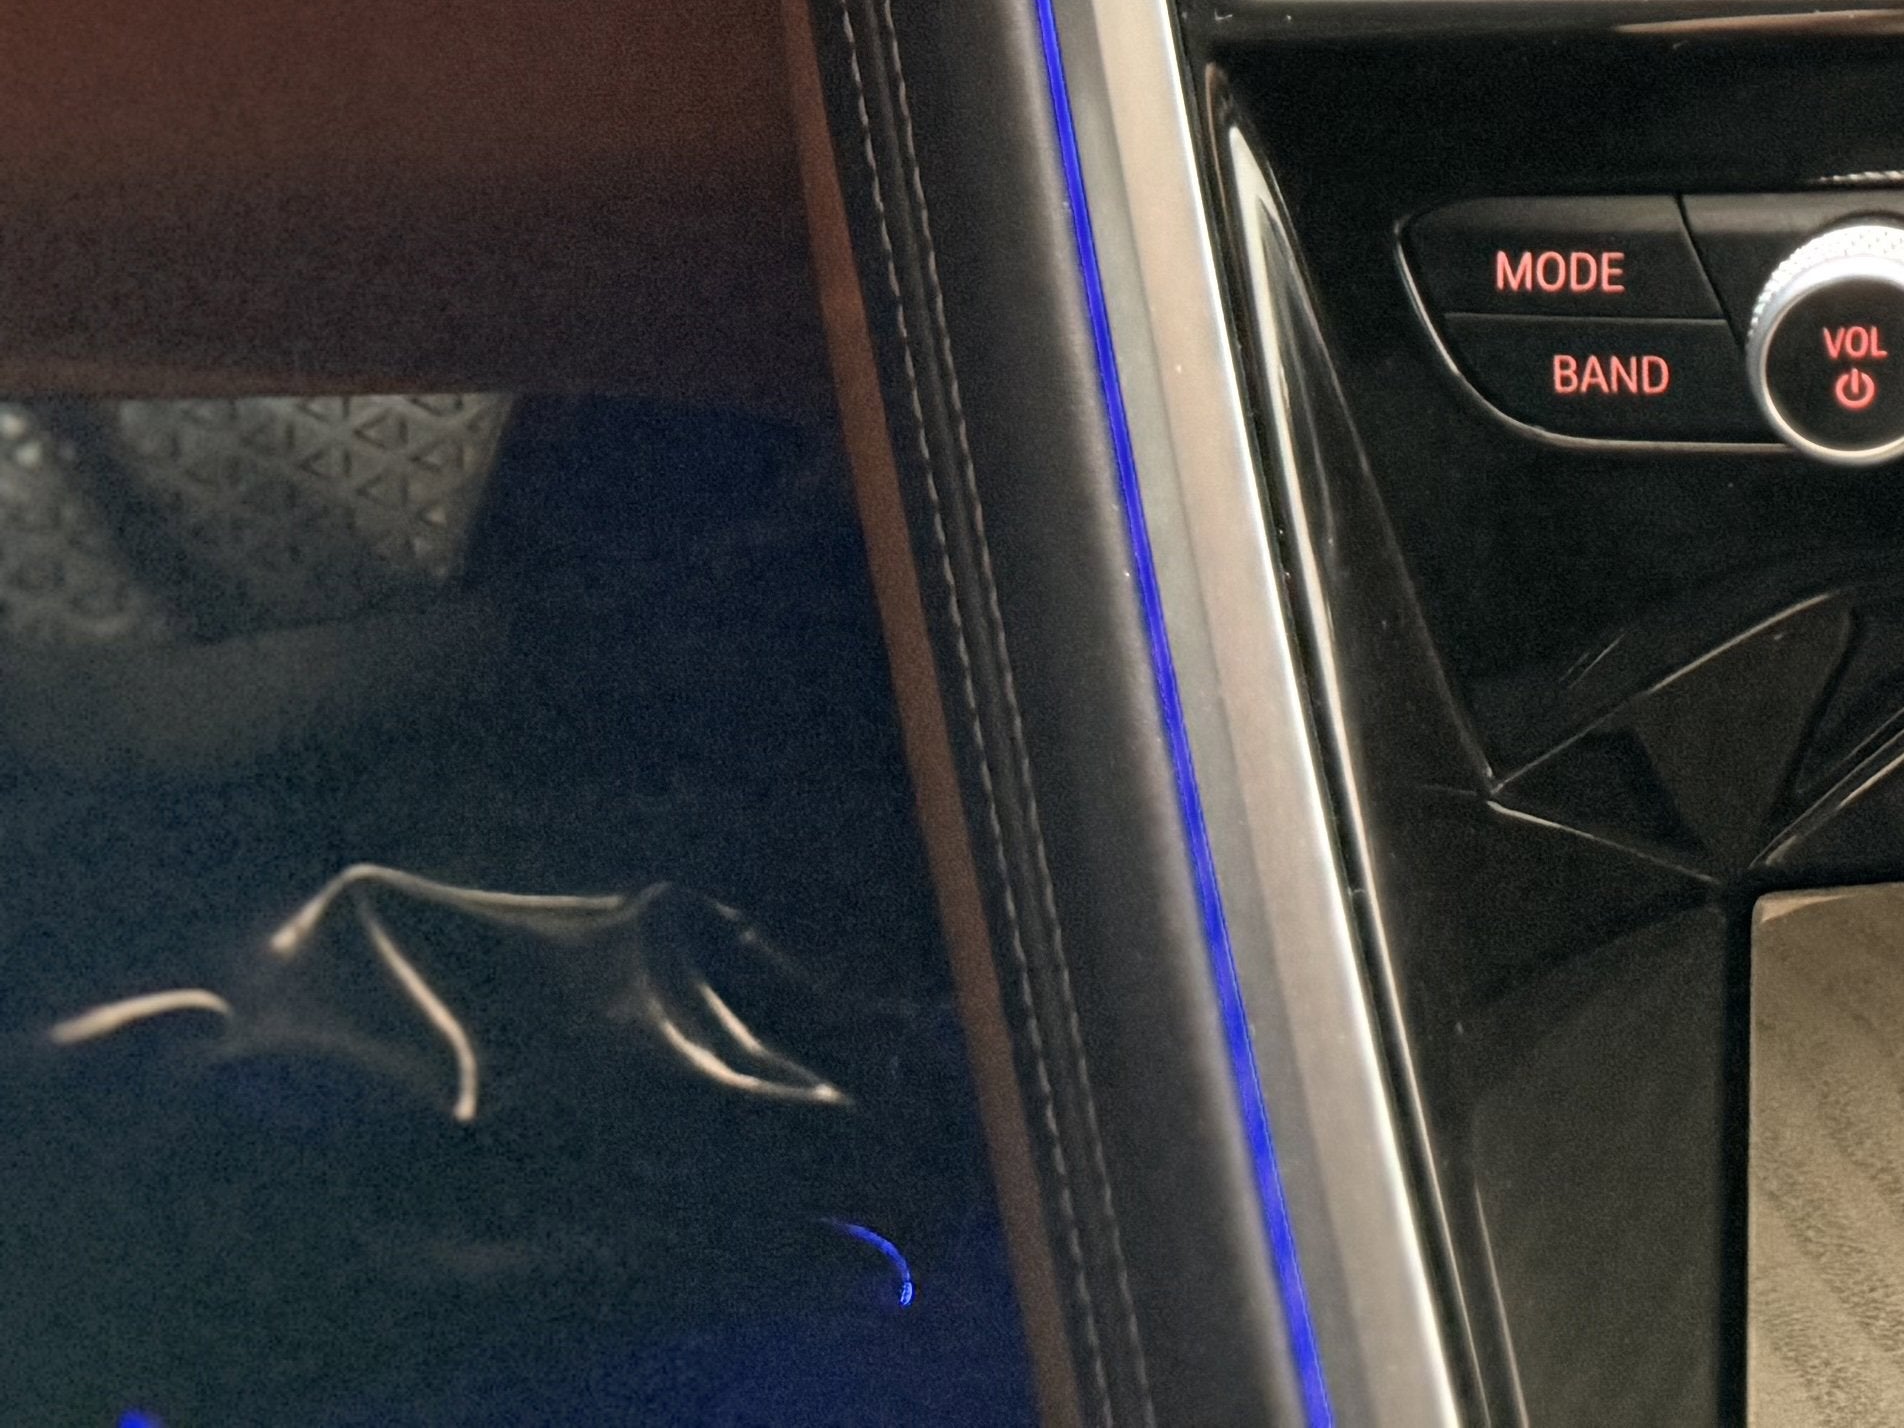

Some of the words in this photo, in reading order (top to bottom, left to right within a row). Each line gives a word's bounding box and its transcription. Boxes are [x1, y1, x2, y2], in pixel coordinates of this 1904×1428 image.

[1494, 249, 1626, 294] MODE
[1821, 325, 1888, 360] VOL
[1551, 354, 1670, 395] BAND
